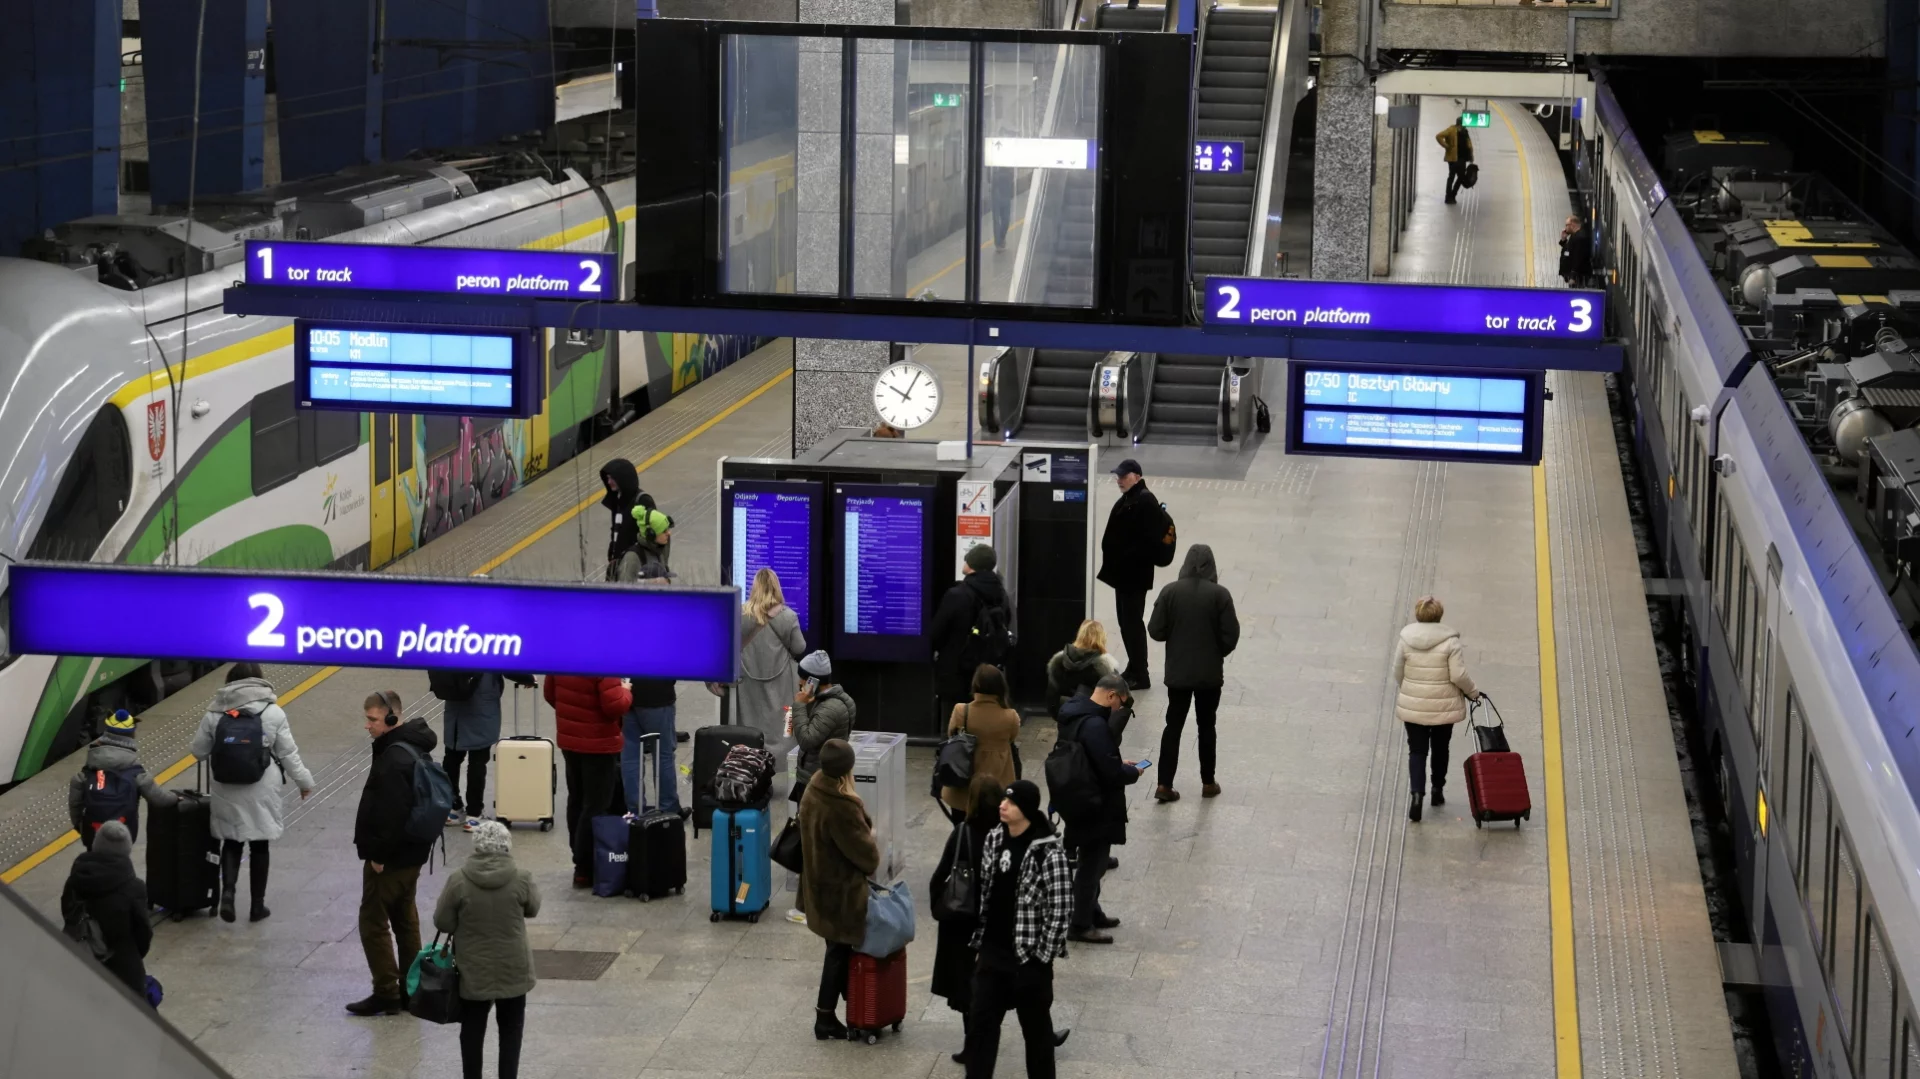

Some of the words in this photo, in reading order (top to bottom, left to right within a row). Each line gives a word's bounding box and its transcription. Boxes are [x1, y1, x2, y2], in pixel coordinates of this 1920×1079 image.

[259, 48, 265, 70] 2
[1204, 145, 1212, 156] 4
[257, 247, 273, 280] 1
[287, 267, 310, 280] tor
[316, 267, 353, 282] track
[456, 275, 501, 290] peron
[506, 274, 570, 292] platform
[579, 260, 602, 292] 2
[1217, 286, 1241, 319] 2
[1250, 308, 1297, 323] peron
[1303, 307, 1371, 325] platform
[1485, 314, 1510, 329] tor
[1517, 314, 1557, 331] track
[1567, 298, 1593, 332] 3
[310, 330, 340, 346] 10:05
[350, 332, 388, 348] Modlin
[1305, 372, 1340, 388] 07:50
[1348, 374, 1400, 391] Olsztyn
[1402, 376, 1451, 394] Główny
[734, 493, 759, 501] Odjazdy
[776, 494, 810, 502] Departures
[846, 498, 875, 506] Przyjazdy
[899, 499, 922, 507] Arrivals
[247, 592, 285, 647] 2
[296, 626, 383, 654] peron
[396, 623, 522, 658] platform
